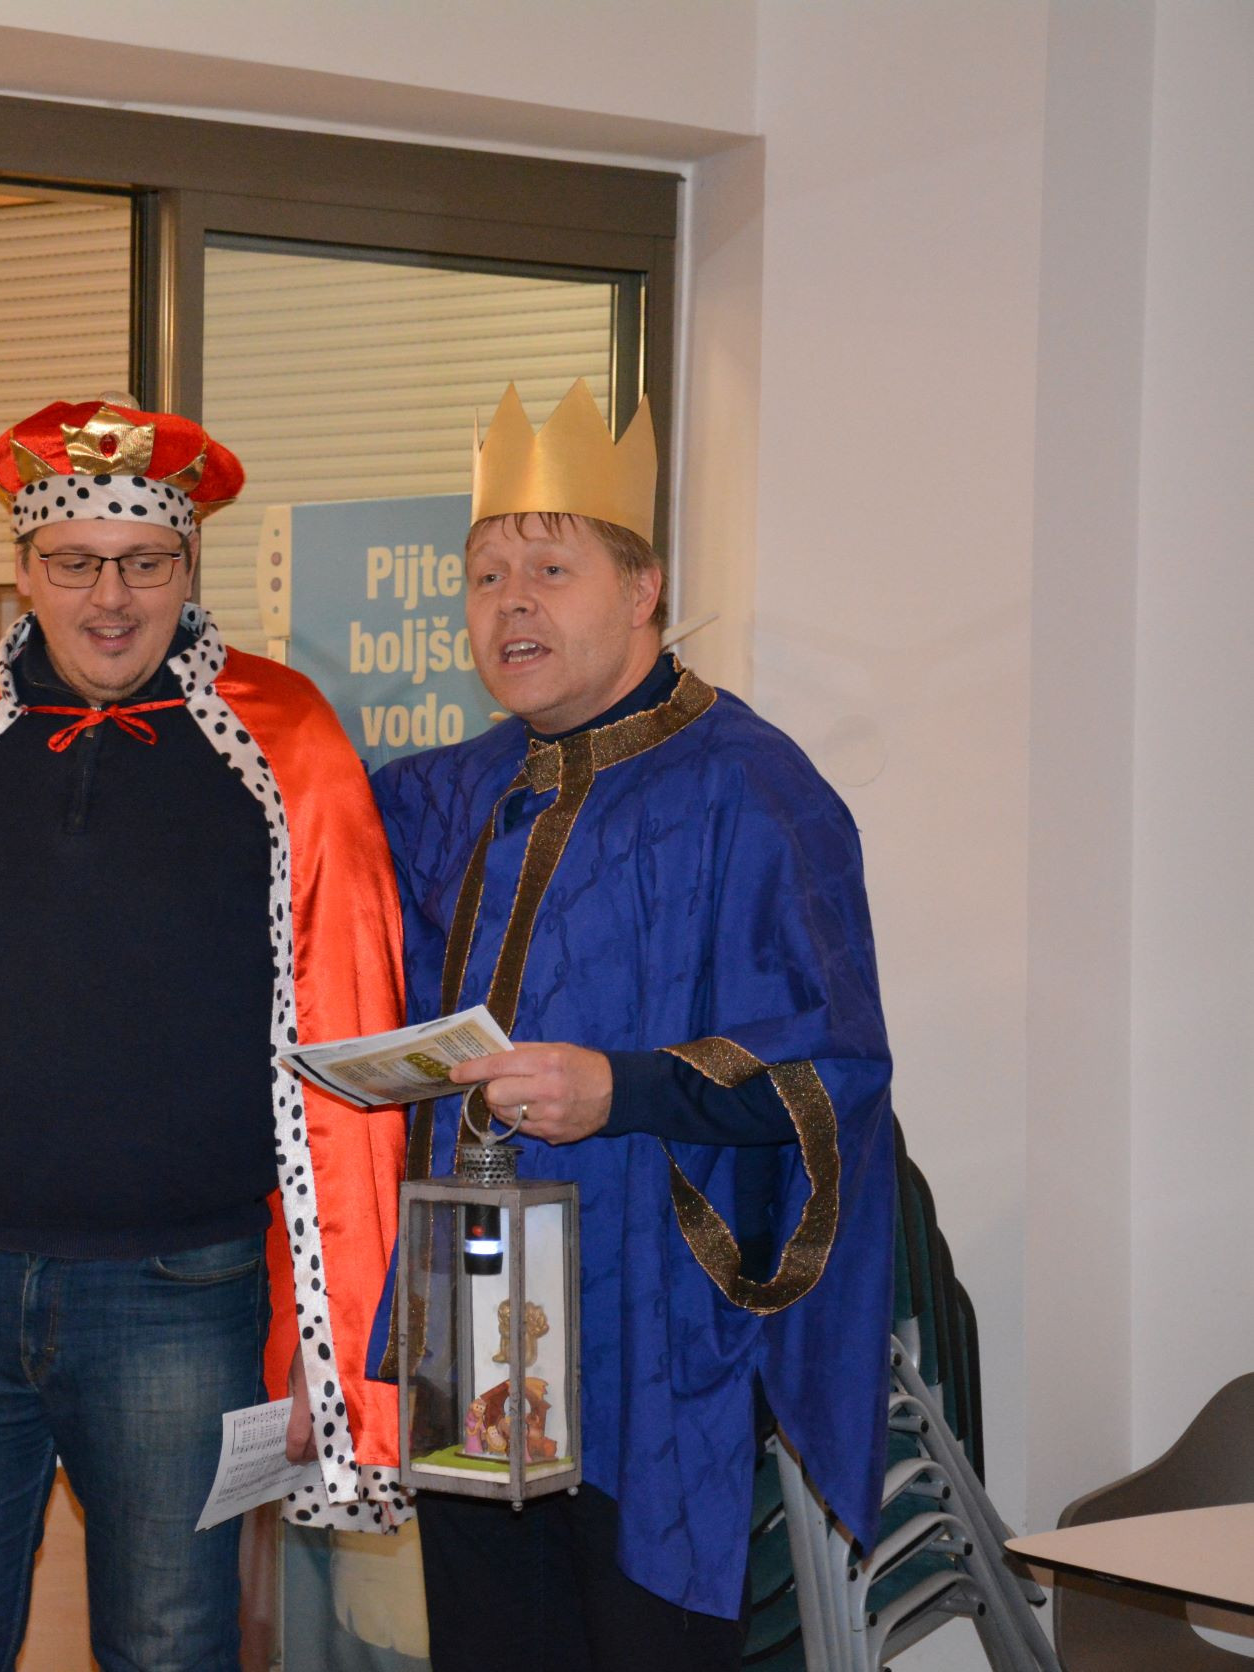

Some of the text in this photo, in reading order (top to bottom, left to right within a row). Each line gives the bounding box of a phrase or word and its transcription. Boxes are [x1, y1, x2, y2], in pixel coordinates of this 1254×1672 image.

[366, 544, 462, 610] Pijte
[350, 616, 476, 684] boljšo
[361, 692, 465, 747] vodo
